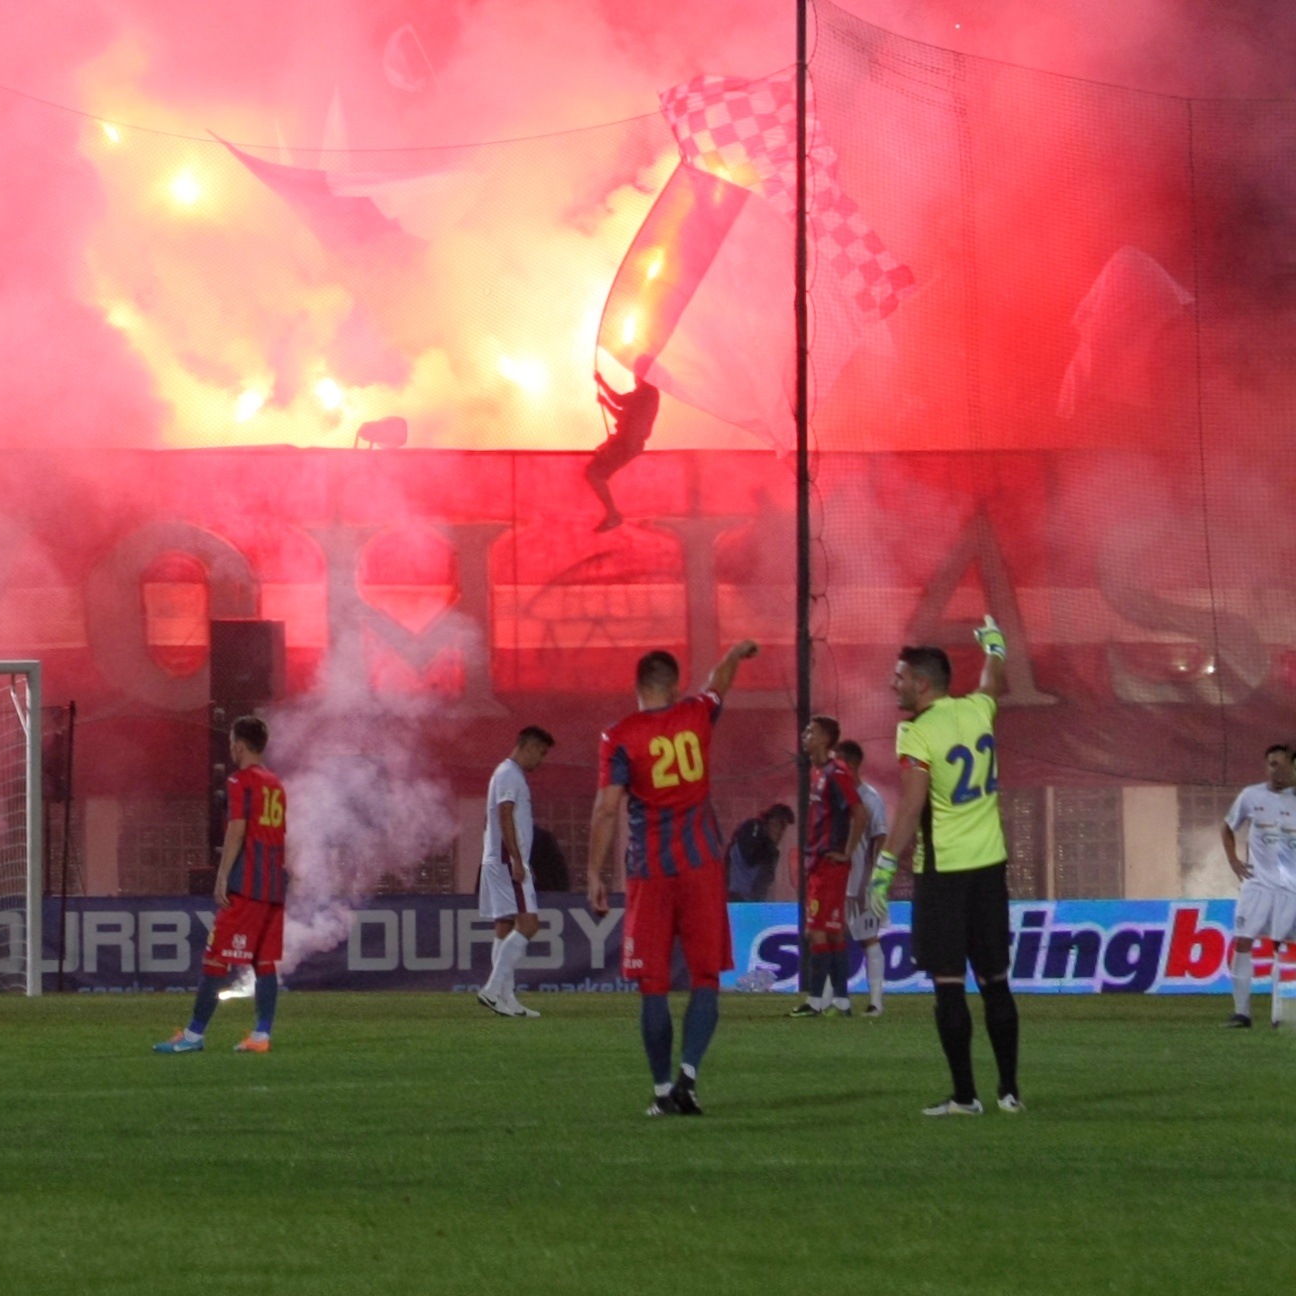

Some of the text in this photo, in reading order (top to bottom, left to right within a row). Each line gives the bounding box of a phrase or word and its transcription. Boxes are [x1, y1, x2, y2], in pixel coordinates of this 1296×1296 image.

[649, 730, 705, 789] 20
[945, 733, 999, 806] 22
[259, 785, 284, 827] 16
